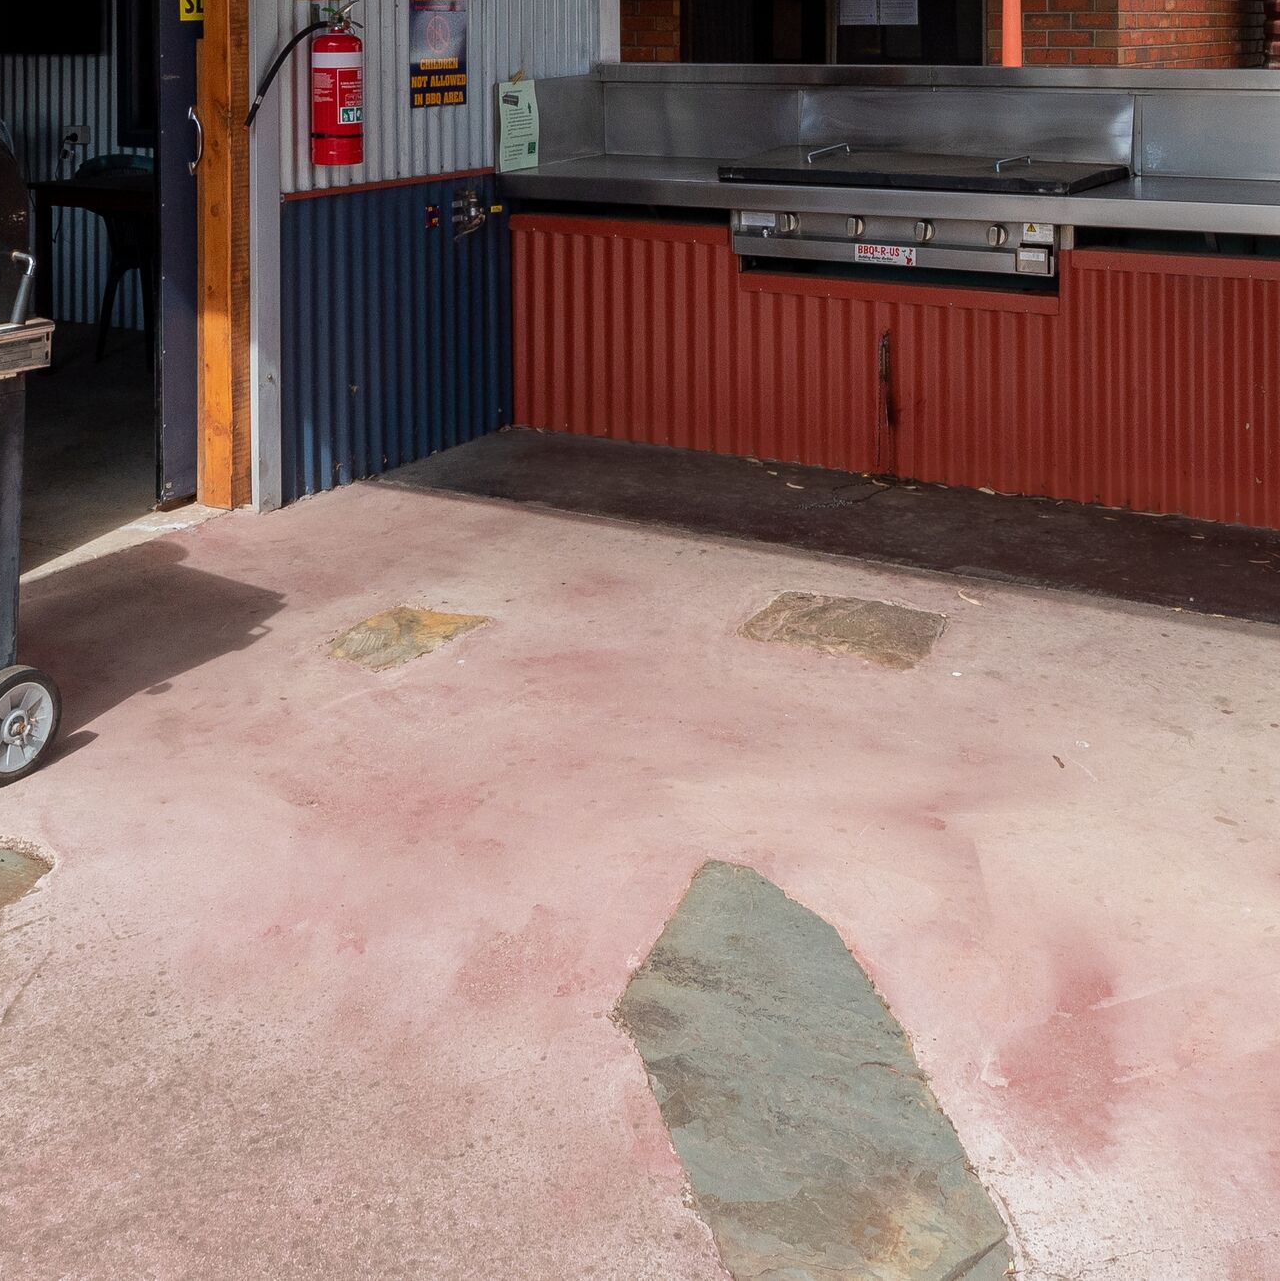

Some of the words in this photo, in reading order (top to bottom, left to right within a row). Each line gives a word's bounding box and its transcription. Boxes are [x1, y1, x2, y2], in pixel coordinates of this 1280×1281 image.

[420, 57, 458, 70] CHILDREN
[411, 76, 428, 88] NOT
[430, 74, 467, 87] ALLOWED
[414, 94, 423, 105] IN
[426, 92, 441, 104] BBQ
[444, 91, 464, 104] AREA
